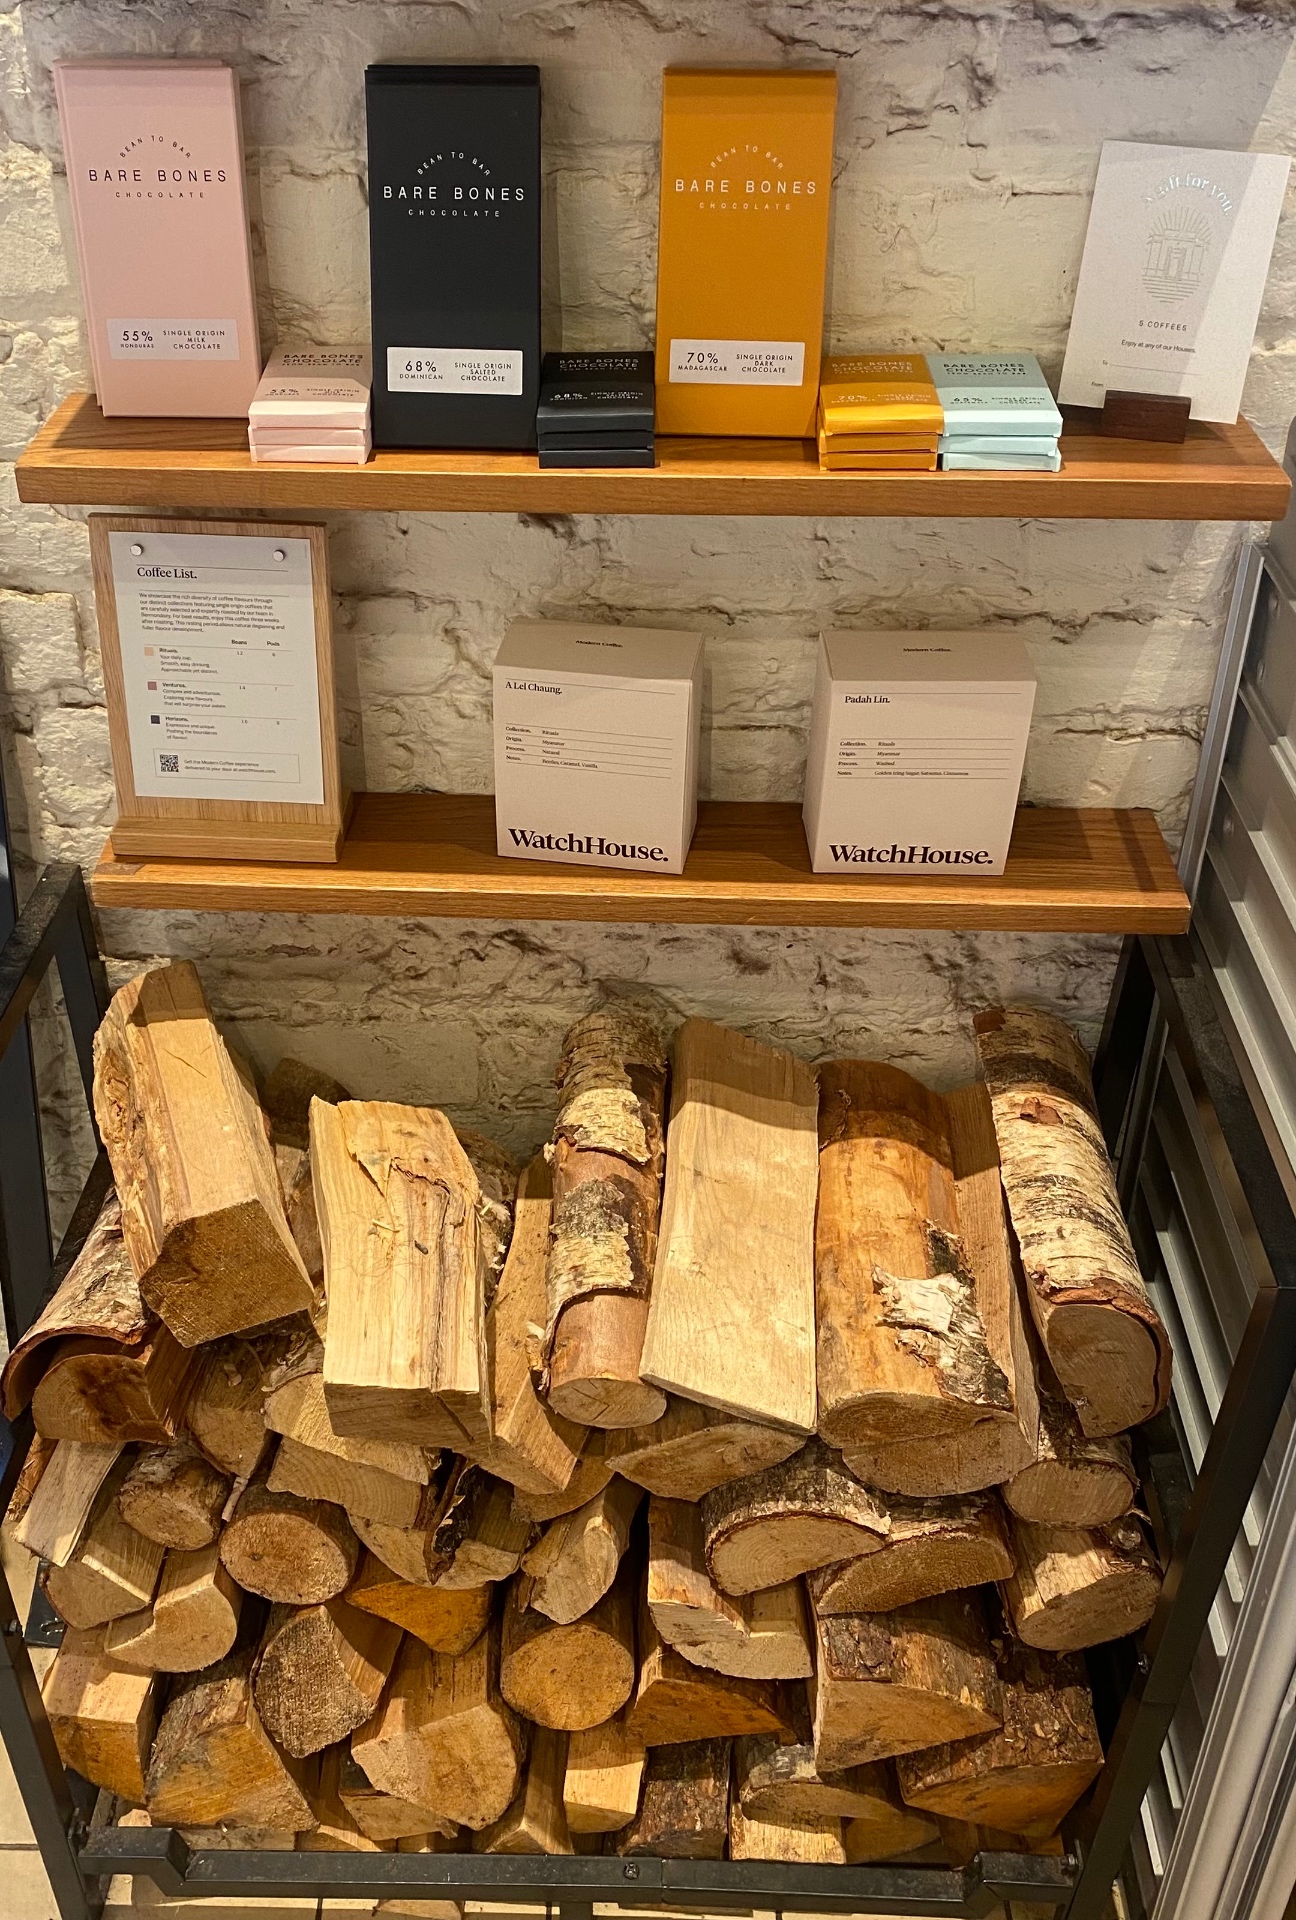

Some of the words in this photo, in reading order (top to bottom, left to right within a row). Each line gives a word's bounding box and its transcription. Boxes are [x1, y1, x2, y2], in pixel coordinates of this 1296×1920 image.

[119, 137, 143, 158] BEAN
[151, 135, 164, 143] TO
[172, 141, 191, 158] BAR
[417, 154, 443, 175] BEAN
[451, 151, 464, 159] TO
[472, 158, 491, 176] BAR
[710, 147, 736, 168] BEAN
[745, 145, 759, 153] TO
[765, 151, 783, 169] BAR
[89, 169, 142, 182] BARE
[157, 169, 227, 182] BONES
[1184, 172, 1210, 190] for
[675, 179, 729, 193] BARE
[746, 180, 816, 194] BONES
[383, 186, 437, 199] BARE
[454, 187, 524, 201] BONES
[700, 202, 790, 210] CHOCOLATE
[408, 209, 500, 217] CHOCOLATE
[1147, 321, 1187, 331] COFFEES
[122, 330, 154, 342] 55%
[1121, 339, 1137, 348] Enjoy
[687, 352, 719, 364] 70%
[405, 360, 437, 372] 68%
[137, 567, 172, 578] Coffee
[173, 569, 198, 579] List.
[505, 681, 512, 689] A
[528, 683, 563, 695] Chaung.
[845, 695, 872, 703] Padah
[873, 695, 891, 704] Lin.
[508, 828, 669, 862] WatchHouse.
[829, 844, 994, 865] WatchHouse.
